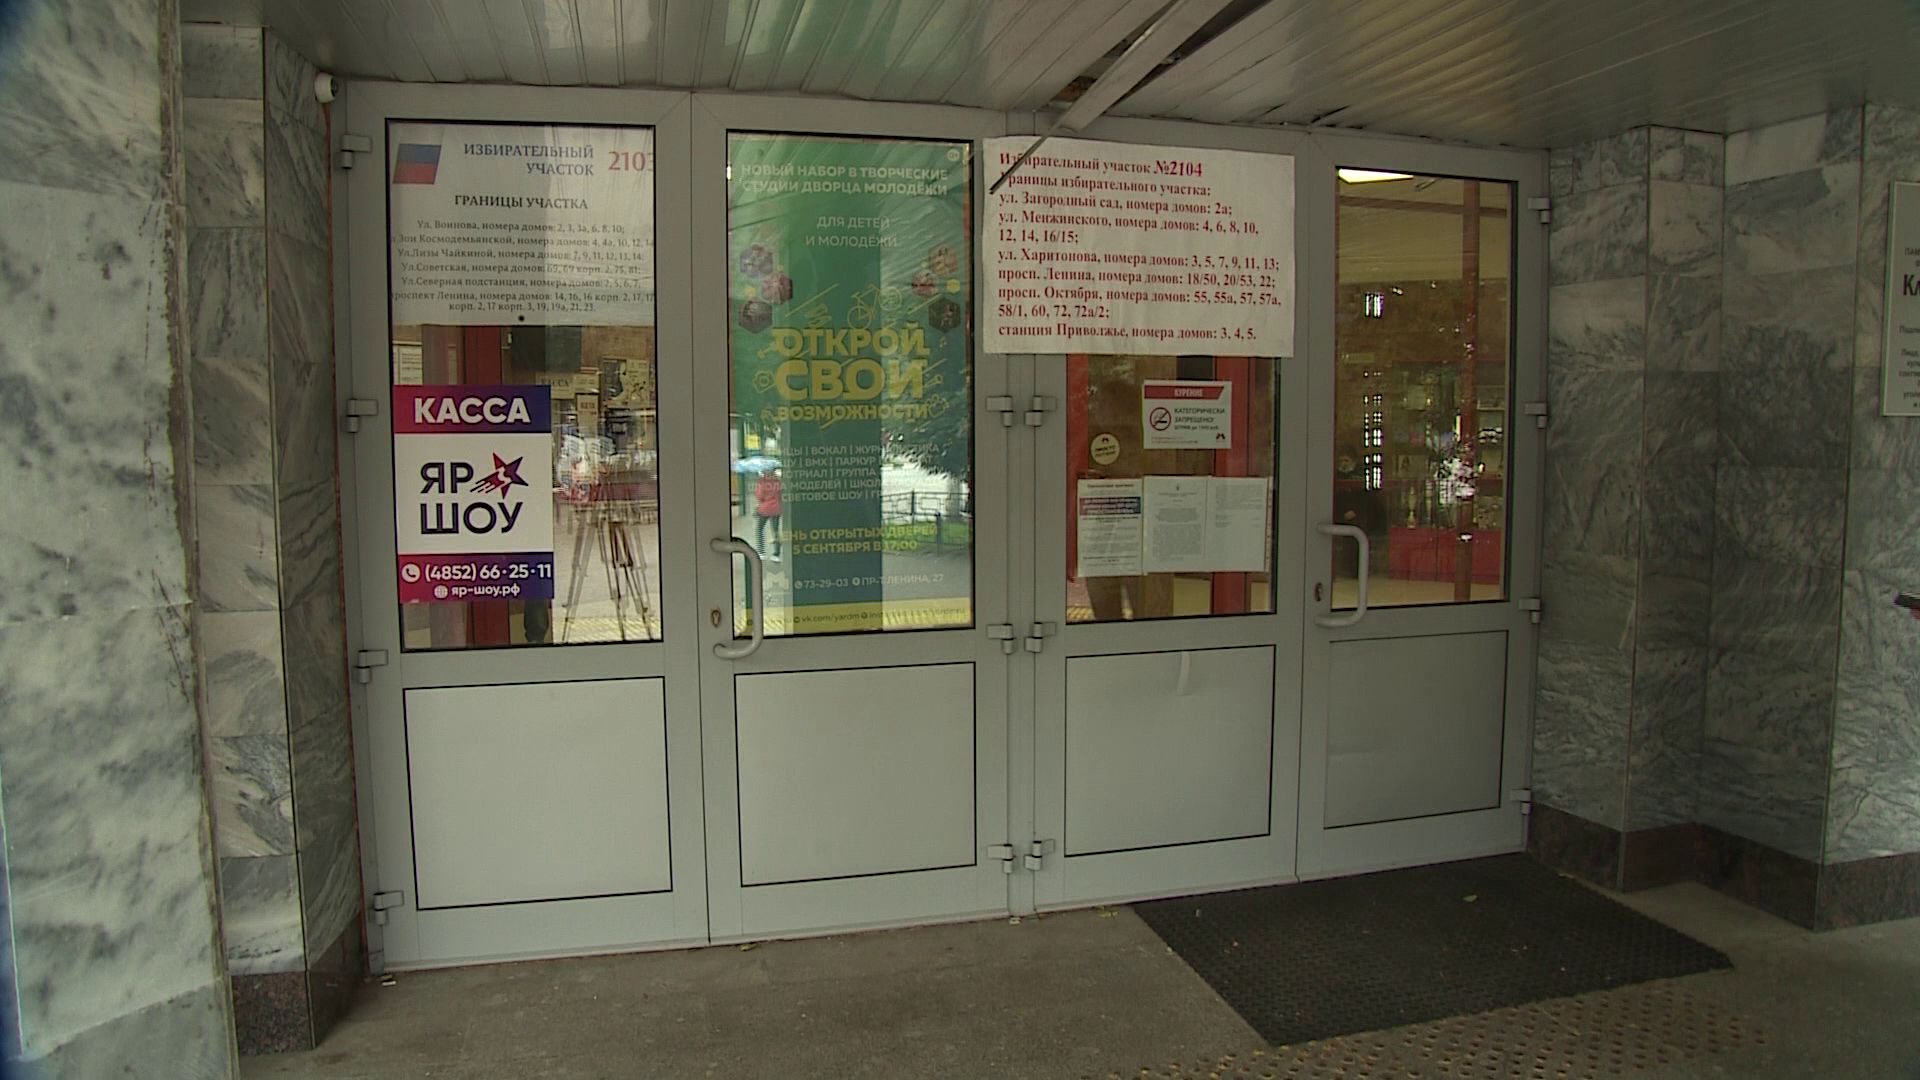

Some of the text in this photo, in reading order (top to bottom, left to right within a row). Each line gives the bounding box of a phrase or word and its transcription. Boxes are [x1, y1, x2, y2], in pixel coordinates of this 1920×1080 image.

[463, 143, 594, 158] ИЗБИРАТЕЛЬНЫЙ
[526, 162, 594, 176] УЧАСТОК
[741, 163, 948, 181] НОВЫЙ НАБОР В ТВОРЧЕСКИЕ
[1103, 160, 1151, 174] участок
[1153, 160, 1203, 177] №2104
[742, 180, 798, 193] СТУДИИ
[801, 180, 861, 194] ДВОРЦА
[1000, 172, 1211, 196] раницы избирательного участка:
[455, 195, 588, 209] ГРАНИЦЫ УЧАСТКА
[1000, 192, 1232, 215] ул. Загородный сад, номера домов: 2а;
[482, 222, 519, 232] номера
[817, 215, 890, 229] ДЛЯ ДЕТЕЙ
[999, 211, 1259, 235] ул. Менжинского, номера домов: 4, 6, 8, 10,
[518, 238, 554, 247] номера
[806, 236, 815, 246] И
[1000, 229, 1079, 244] 12, 14, 16/15;
[498, 251, 535, 260] номера
[998, 248, 1279, 271] ул. Харитонова, номера домов: 3, 5, 7, 9, 11, 13;
[472, 265, 508, 274] номера
[465, 278, 528, 287] подстанции,
[998, 268, 1275, 288] просп. Ленина, номера домов: 18/50, 20/53, 22;
[438, 292, 477, 301] Ленина,
[480, 293, 516, 302] номера
[998, 286, 1281, 306] просп. Октября, номера домов: 55, 55а, 57, 57а,
[449, 303, 475, 312] корп.
[998, 304, 1109, 319] 58/1, 60, 72, 72а/2;
[998, 323, 1256, 340] станция Приволжье, номера домов: 3, 4, 5.
[771, 321, 930, 357] ОТКРОЙ
[414, 397, 531, 424] КАССА
[777, 404, 928, 422] ВОЗМОЖНОСТИ
[1174, 407, 1225, 415] КАТЕГОРИЧЕСКИ
[811, 445, 847, 455] ВОКАЛ
[835, 457, 876, 467] ПАРКУР
[420, 462, 474, 494] ЯР
[835, 468, 877, 478] ГРУППА
[790, 479, 841, 491] МОДЕЛЕЙ
[781, 491, 835, 502] СВЕТОВОЕ
[838, 490, 861, 500] ШОУ
[420, 502, 524, 535] ШОУ
[809, 527, 884, 540] ОТКРЫТЫХ
[886, 523, 937, 537] ДВЕРЕЙ
[803, 542, 871, 554] СЕНТЯБРЯ
[425, 563, 477, 582] (4852)
[451, 583, 521, 598] яр-шоу.рф
[803, 578, 849, 589] 73-29-03
